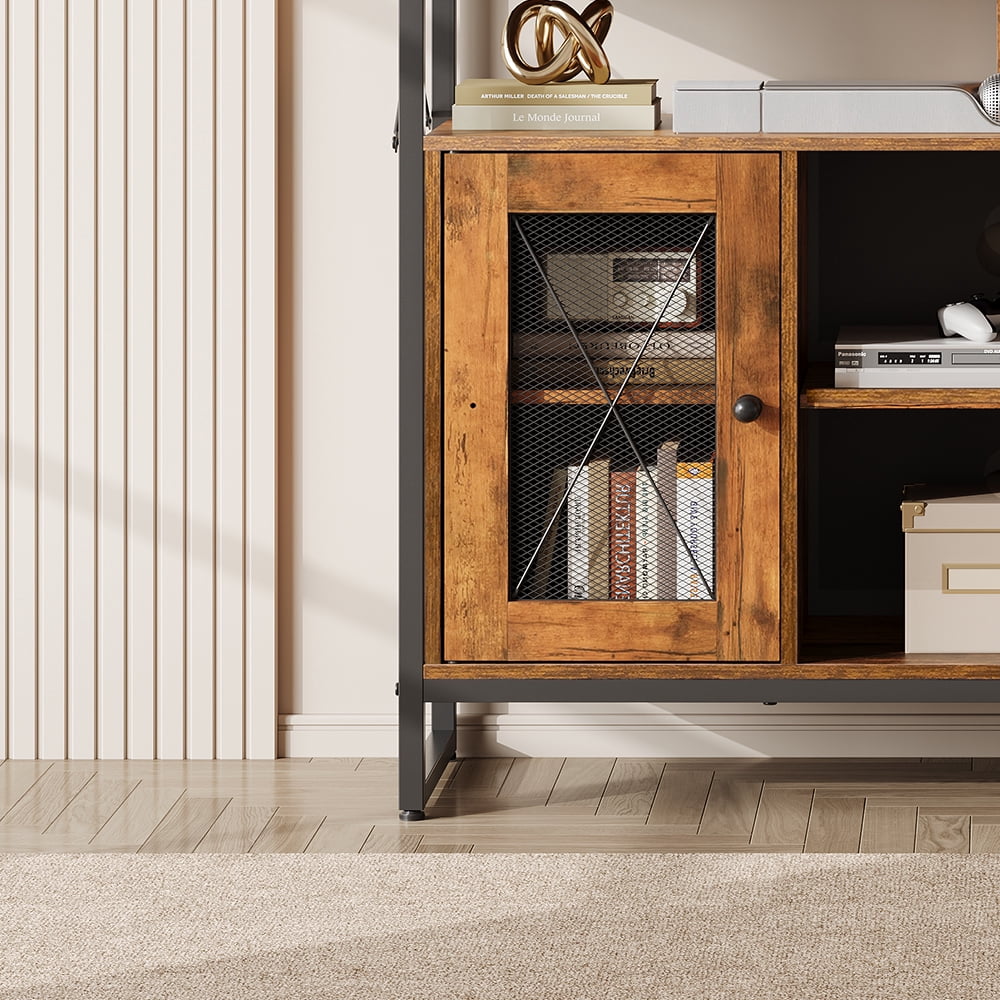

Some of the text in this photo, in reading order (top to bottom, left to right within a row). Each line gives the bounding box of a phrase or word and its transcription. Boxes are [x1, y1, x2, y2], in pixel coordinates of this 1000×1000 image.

[513, 112, 601, 124] Le Monde Journal
